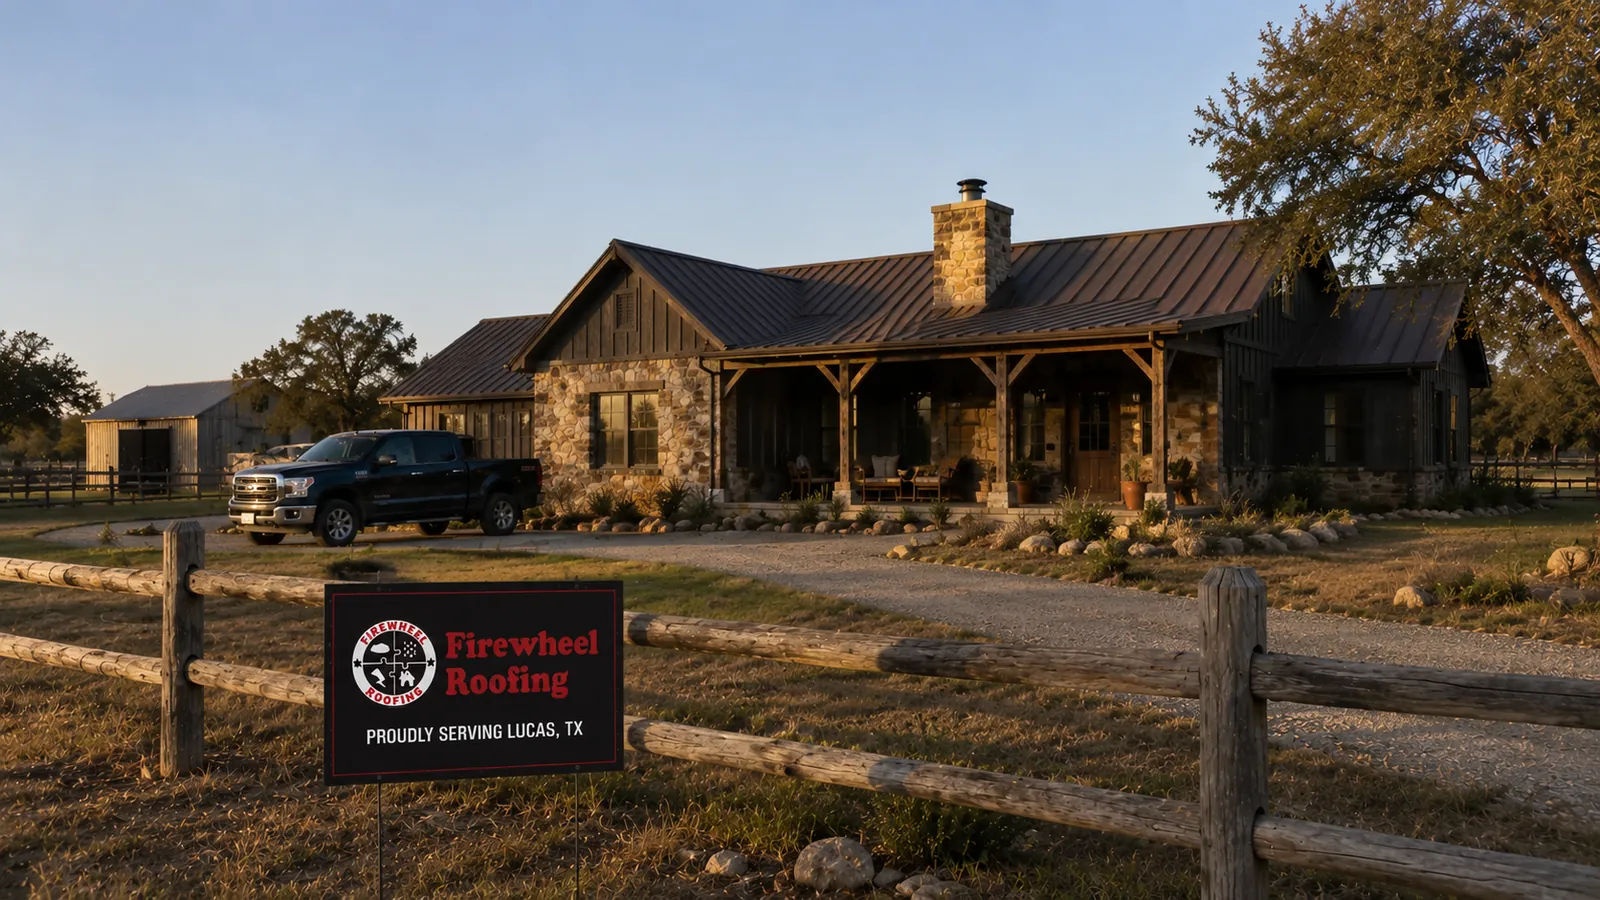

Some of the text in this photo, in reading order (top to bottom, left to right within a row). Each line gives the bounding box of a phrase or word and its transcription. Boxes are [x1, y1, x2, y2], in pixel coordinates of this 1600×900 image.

[361, 621, 428, 645] FIREWHEEL
[446, 629, 599, 659] Firewheel
[446, 665, 569, 699] Roofing
[365, 687, 423, 705] ROOFING
[366, 720, 583, 745] PROUDLY SERVING LUCAS, TX
